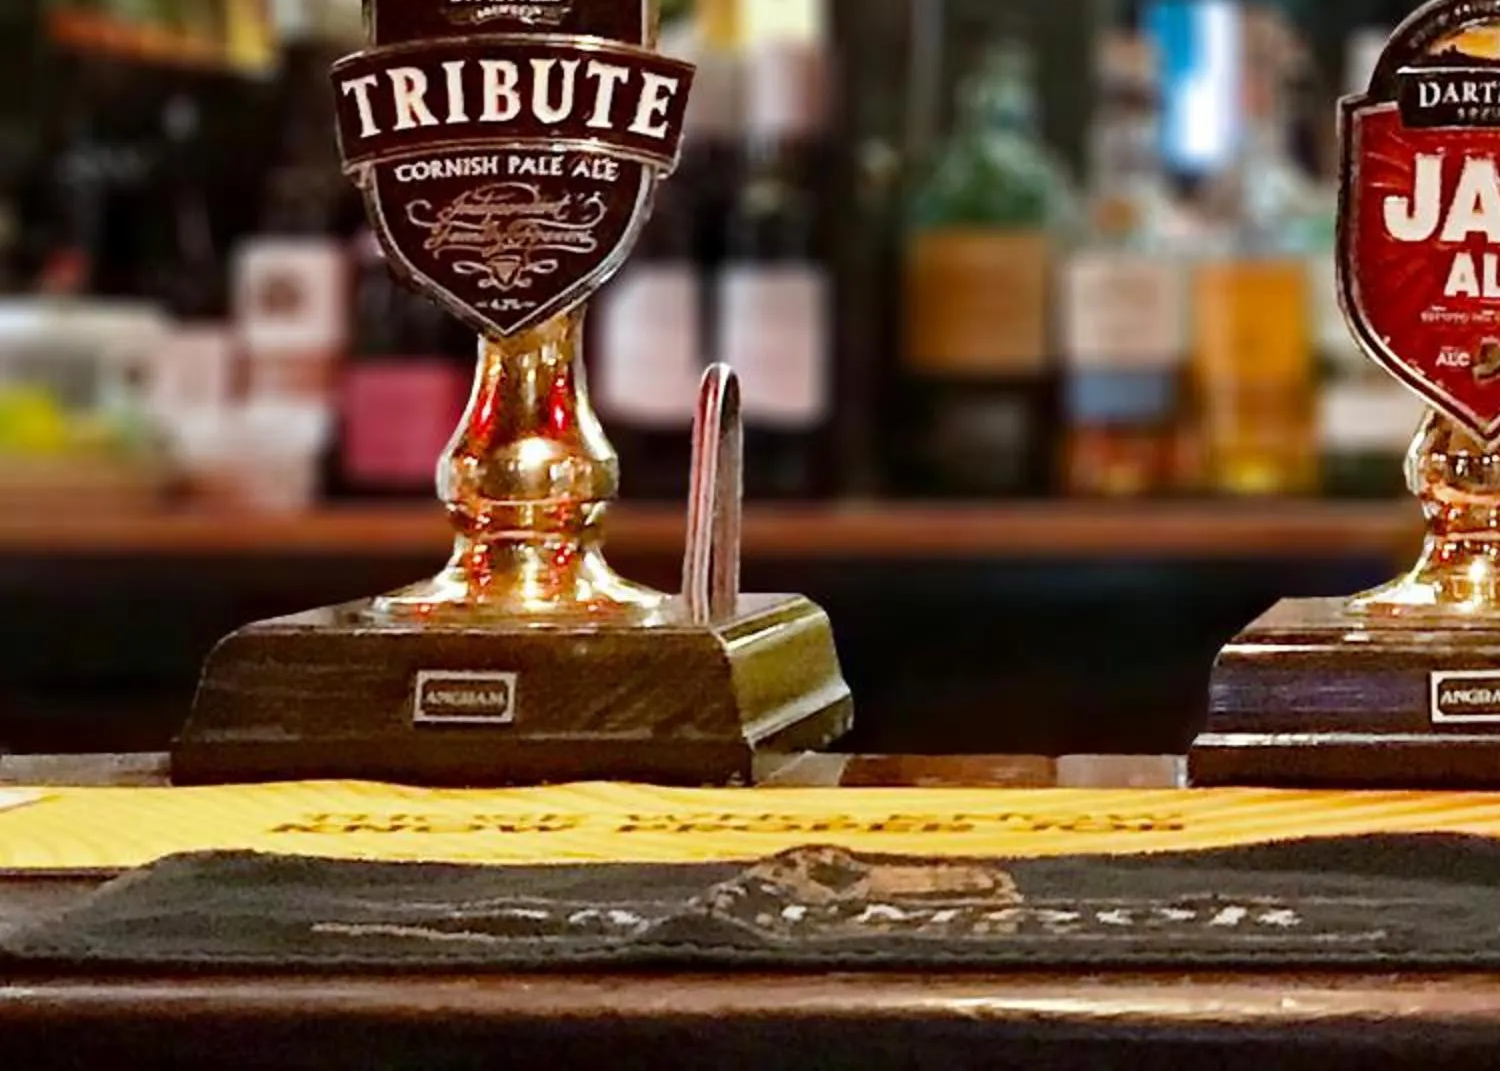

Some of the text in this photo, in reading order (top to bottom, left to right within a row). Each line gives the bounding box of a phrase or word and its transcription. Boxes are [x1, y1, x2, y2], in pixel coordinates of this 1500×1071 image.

[342, 59, 679, 139] TRIBUTE
[394, 155, 619, 182] CORNISH PALE ALE
